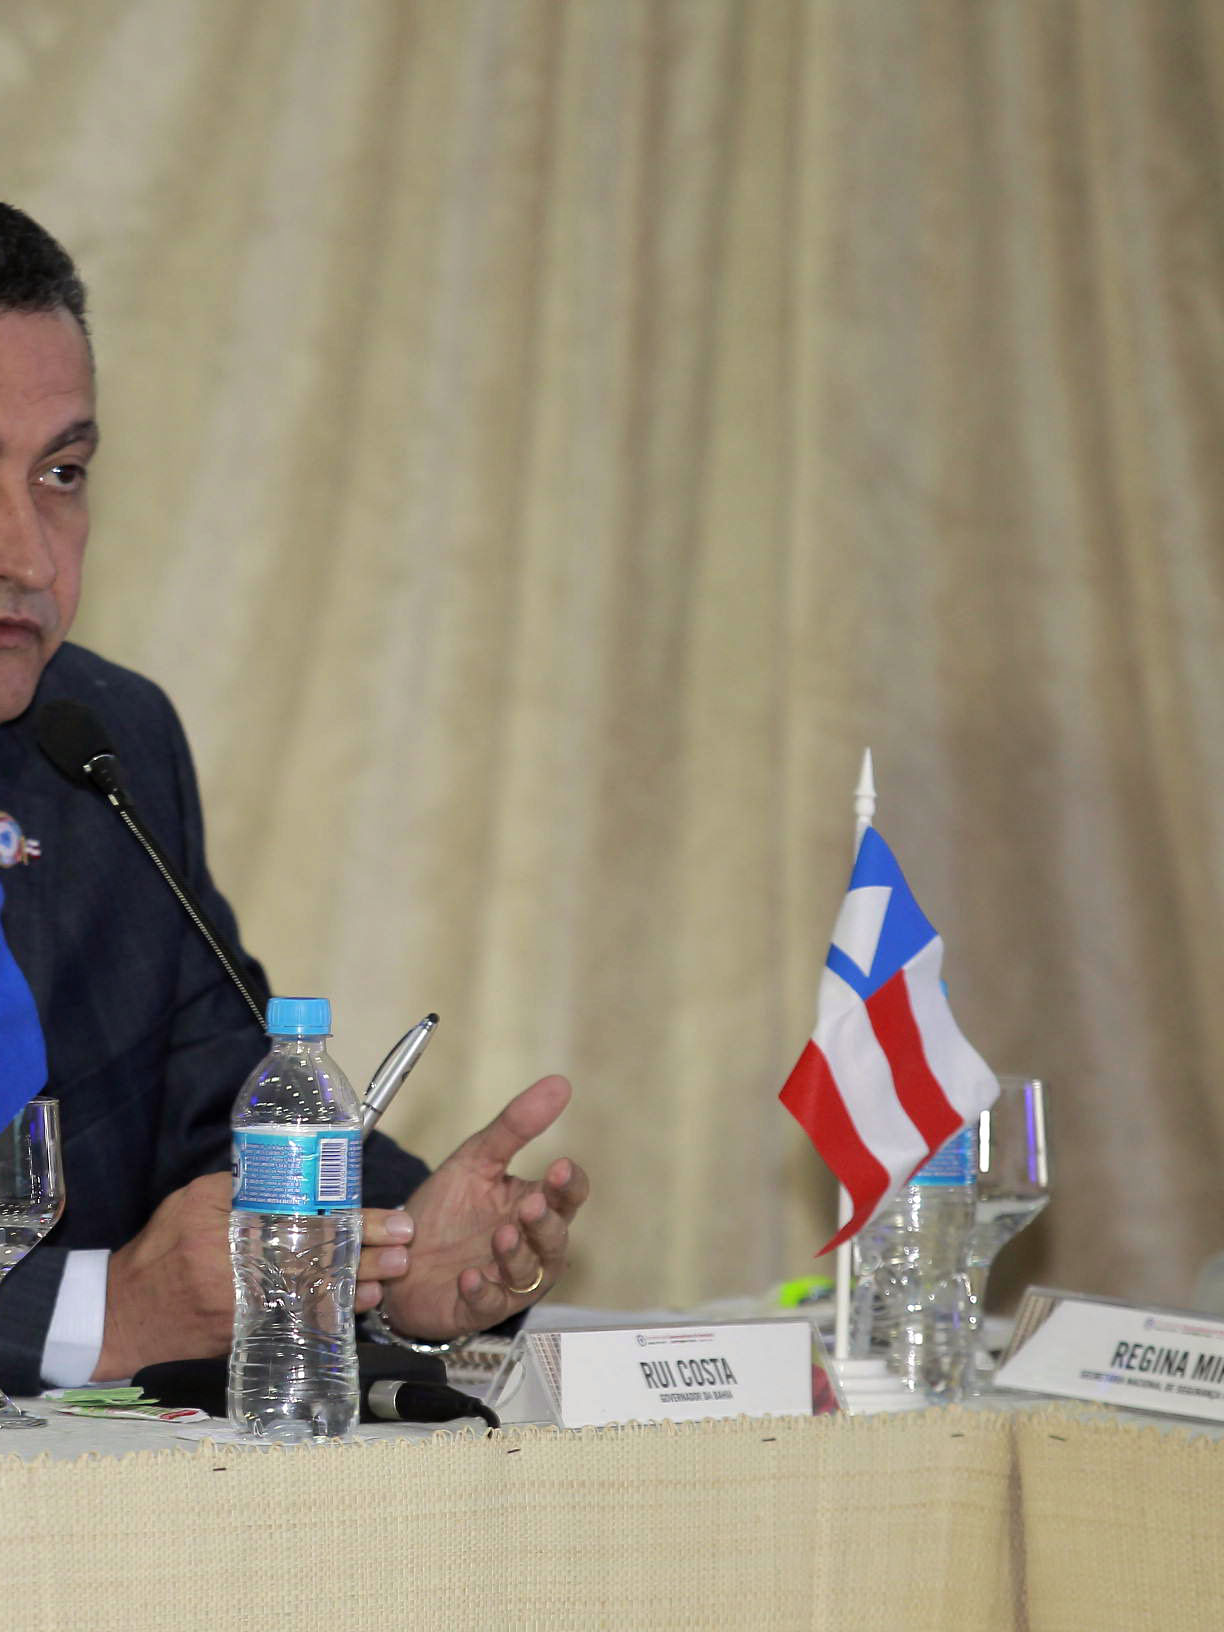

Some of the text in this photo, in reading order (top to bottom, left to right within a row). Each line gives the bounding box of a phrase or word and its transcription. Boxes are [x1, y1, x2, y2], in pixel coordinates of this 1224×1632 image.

[639, 1357, 738, 1389] RUI COSTA
[1110, 1340, 1189, 1379] REGINA
